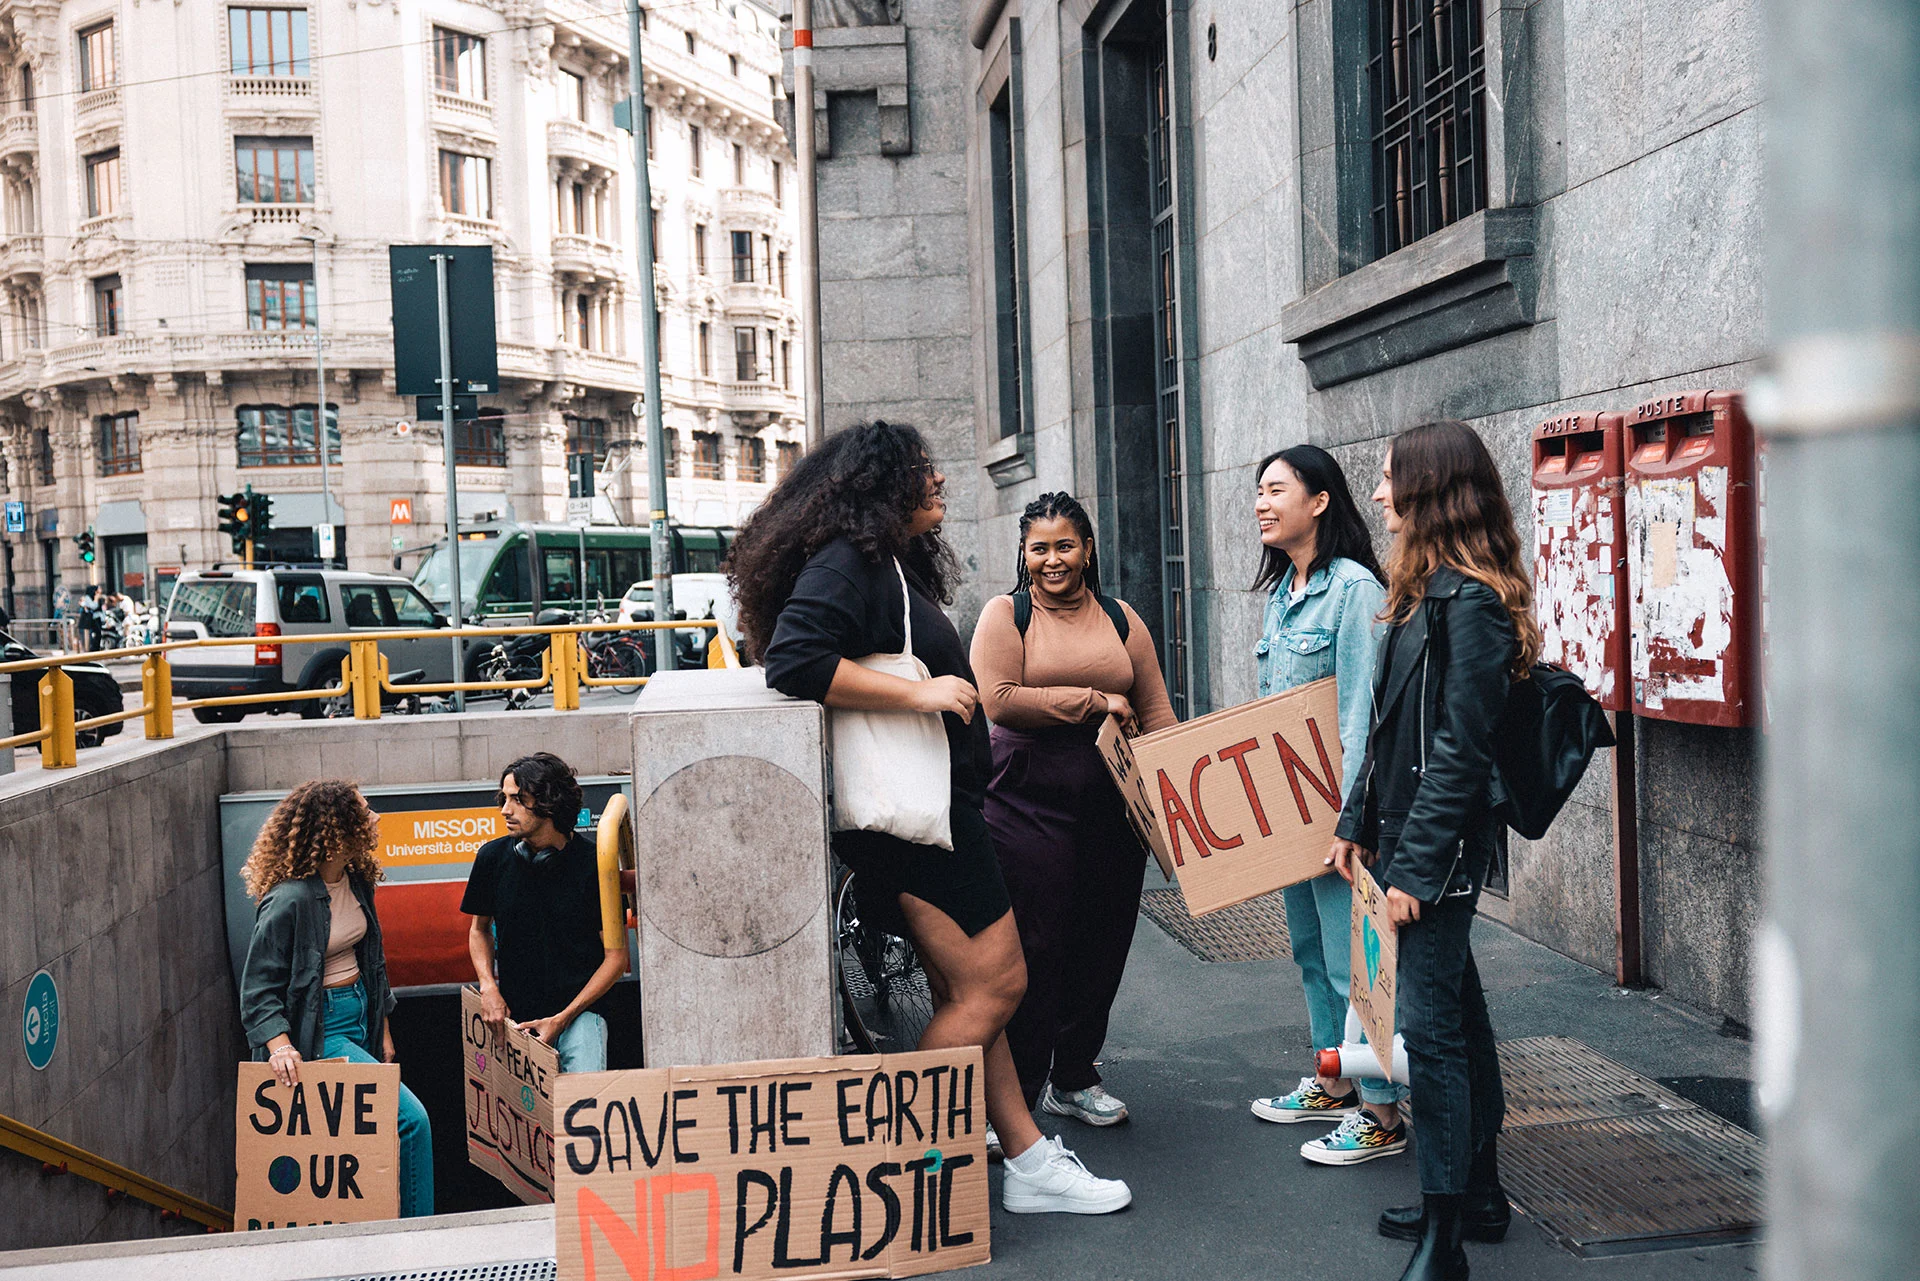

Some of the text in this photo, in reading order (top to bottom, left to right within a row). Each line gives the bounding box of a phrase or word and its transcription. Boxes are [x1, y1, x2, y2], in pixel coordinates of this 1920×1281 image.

[1542, 416, 1580, 434] POSTE
[1638, 396, 1685, 419] POSTE
[391, 503, 410, 520] M
[1108, 736, 1132, 783] WE
[1157, 736, 1273, 867] ACT
[386, 841, 453, 857] Università
[413, 817, 496, 839] MISSORI
[42, 991, 50, 1044] Uscita
[49, 1000, 57, 1028] Exit
[507, 1041, 549, 1099] PEACE
[249, 1079, 377, 1137] SAVE
[563, 1063, 974, 1175] SAVE THE EARTH
[577, 1152, 975, 1281] NO PLASTIC
